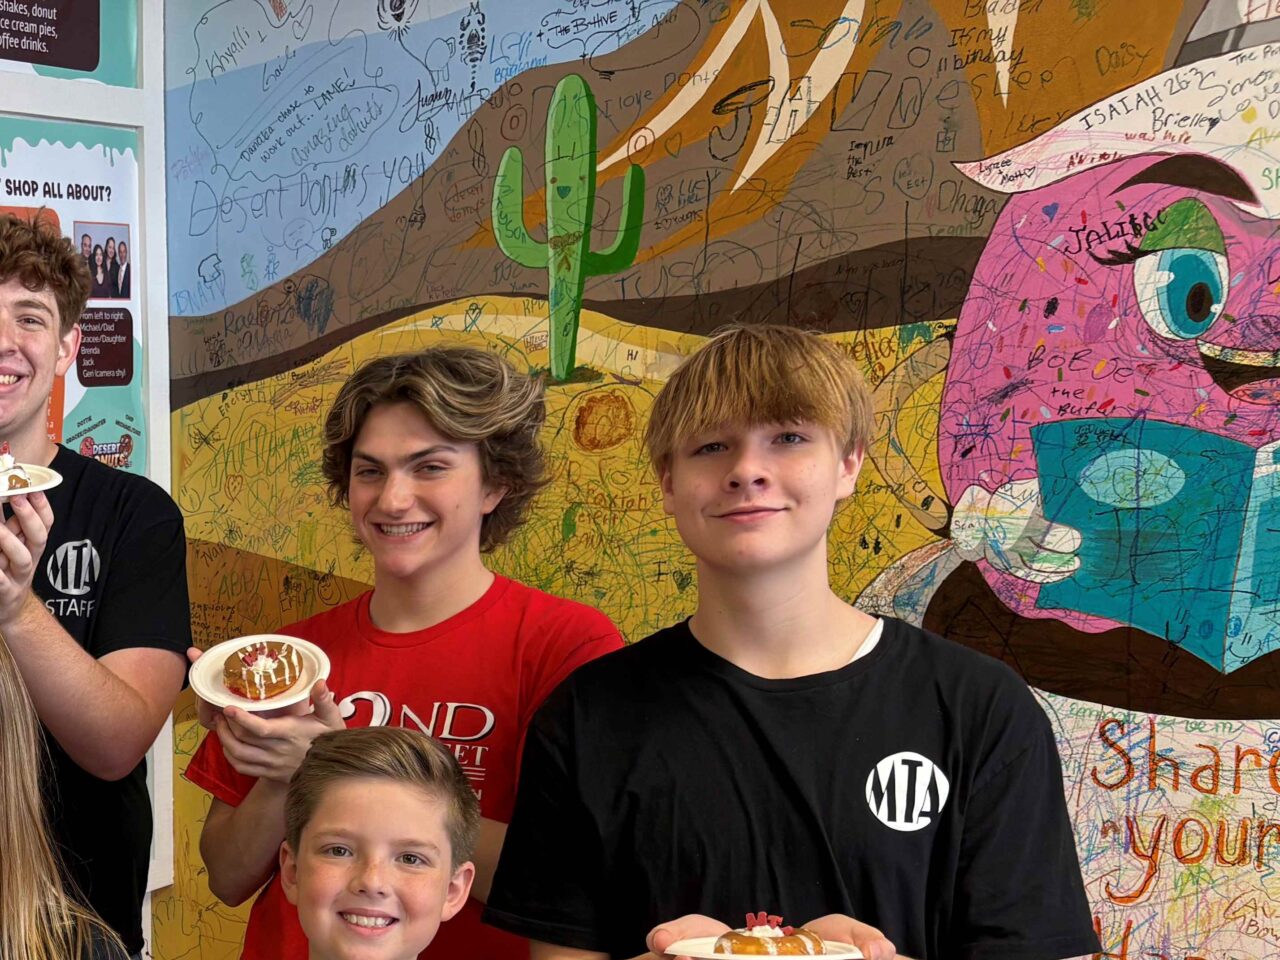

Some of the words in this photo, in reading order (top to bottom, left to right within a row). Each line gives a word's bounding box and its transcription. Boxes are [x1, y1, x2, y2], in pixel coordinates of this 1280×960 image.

[0, 0, 30, 16] shakes,
[32, 3, 57, 19] donut
[11, 19, 37, 34] cream
[39, 22, 58, 39] pies,
[548, 24, 570, 36] THE
[21, 37, 48, 52] drinks.
[1079, 87, 1162, 130] ISAIAH
[6, 179, 38, 197] SHOP
[43, 181, 63, 199] ALL
[66, 183, 112, 202] ABOUT?
[82, 358, 94, 367] Jack
[93, 443, 120, 454] DESERT
[48, 540, 99, 594] MTA
[46, 598, 96, 618] STAFF
[867, 753, 946, 829] MTA
[1105, 814, 1280, 906] your
